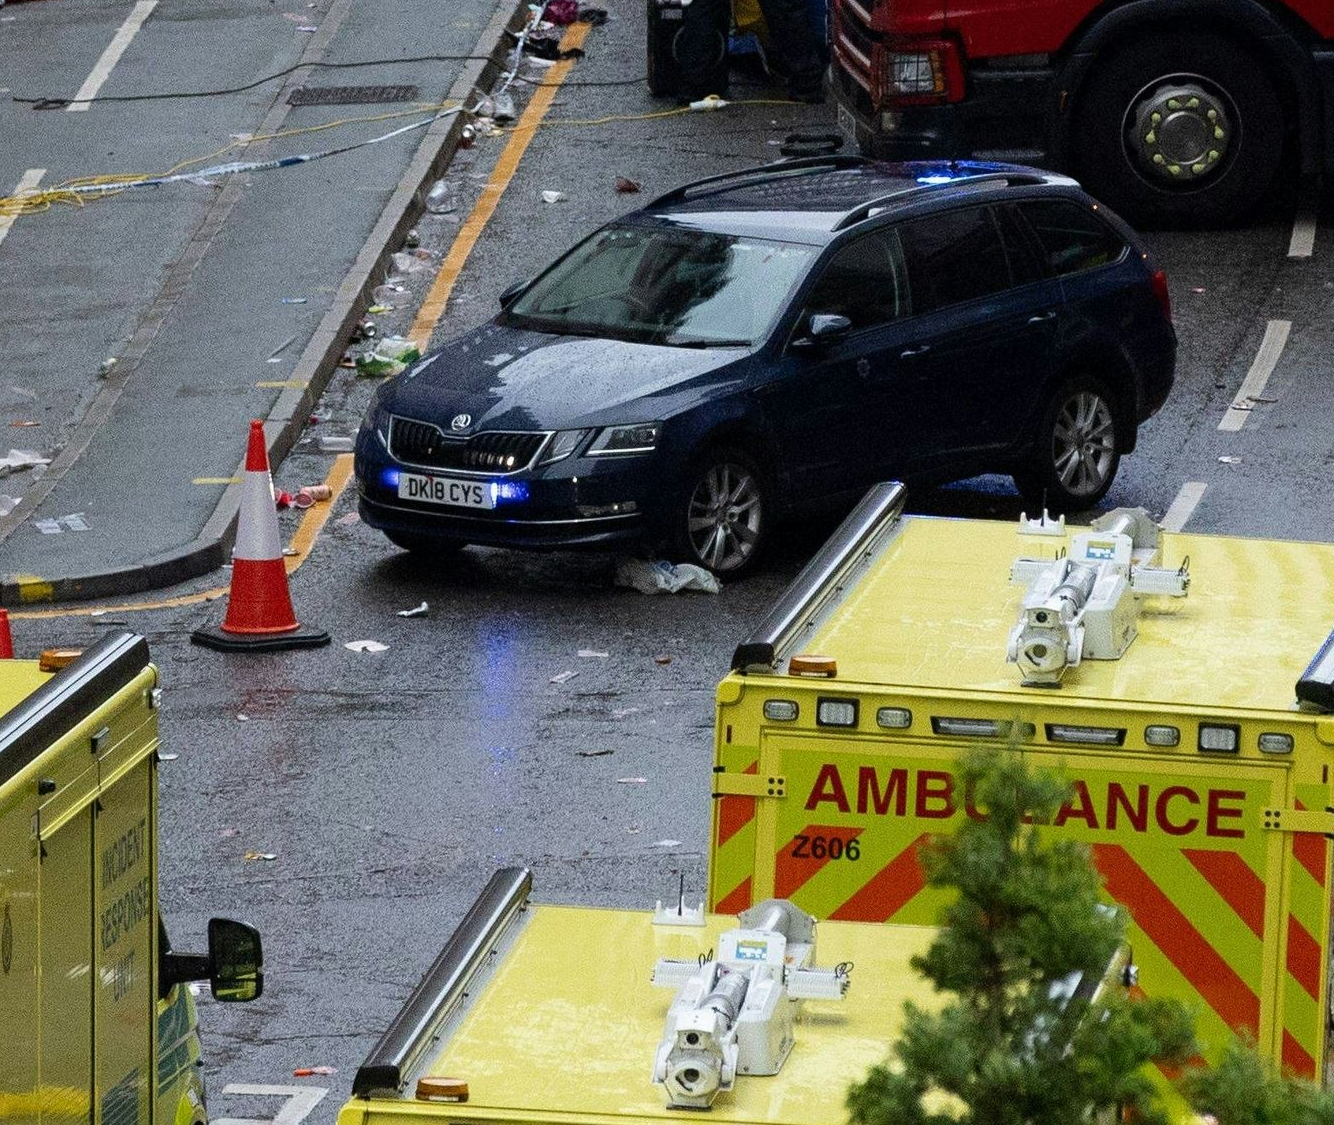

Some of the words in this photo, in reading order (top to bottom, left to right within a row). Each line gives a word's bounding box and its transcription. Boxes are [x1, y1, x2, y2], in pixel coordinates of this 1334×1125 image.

[408, 478, 445, 501] DK18
[449, 483, 483, 504] CYS
[804, 763, 1247, 839] AMBANCE
[102, 818, 146, 890] INCIDENT
[792, 835, 861, 861] Z606
